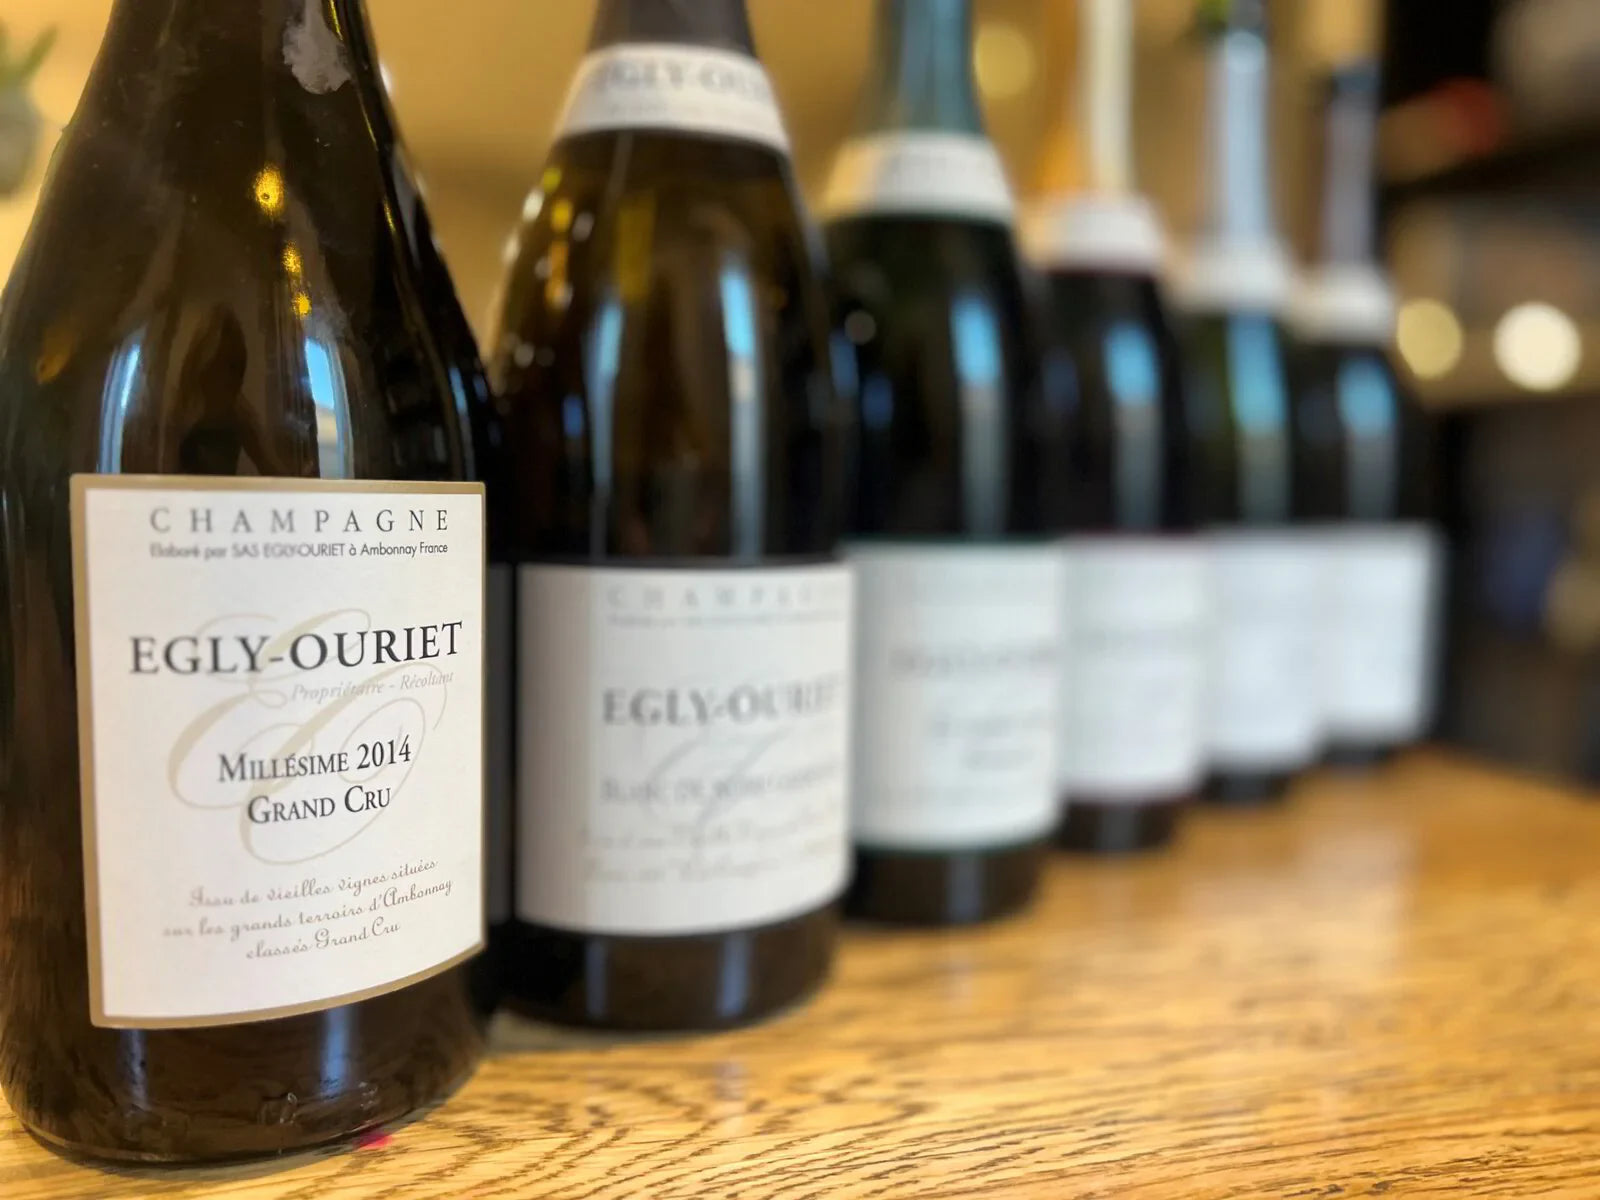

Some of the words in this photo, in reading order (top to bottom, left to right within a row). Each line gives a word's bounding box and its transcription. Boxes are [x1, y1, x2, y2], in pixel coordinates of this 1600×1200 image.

[149, 505, 449, 534] CHAMPAGNE
[204, 546, 227, 562] par
[231, 542, 260, 558] SAS
[349, 543, 357, 557] à
[360, 542, 417, 558] Ambonnay
[420, 541, 448, 554] France
[129, 620, 463, 675] EGLY-OURIET
[291, 681, 385, 705] Propriétaire
[400, 670, 454, 691] Récoltant
[356, 734, 412, 770] 2014
[240, 889, 259, 904] de
[266, 878, 334, 902] vieilles
[338, 873, 389, 897] vignes
[390, 859, 438, 881] situées
[198, 916, 225, 937] les
[230, 913, 293, 943] grands
[299, 904, 365, 926] terroirs
[369, 879, 453, 912] d'Ambonnay
[245, 938, 312, 960] classés
[313, 927, 370, 950] Grand
[371, 915, 401, 938] Cru
